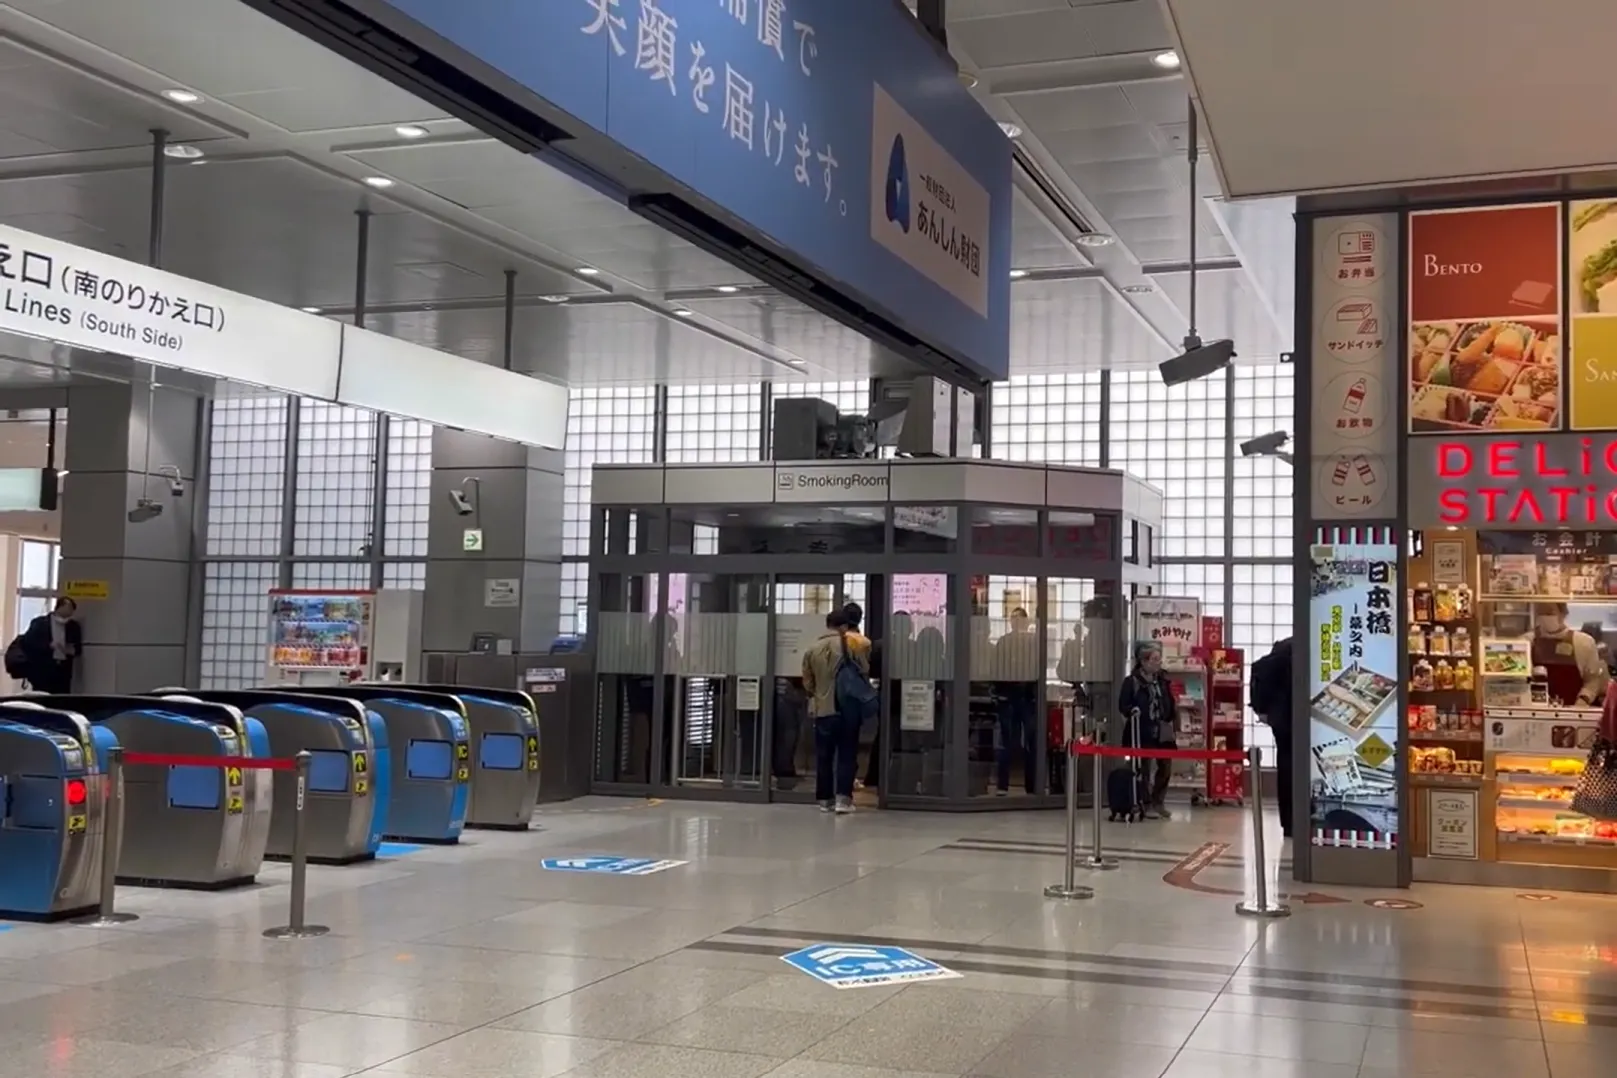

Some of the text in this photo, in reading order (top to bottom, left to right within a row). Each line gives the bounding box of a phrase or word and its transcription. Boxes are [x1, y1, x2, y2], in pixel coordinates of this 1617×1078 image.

[917, 200, 980, 277] あんしん財団
[1337, 267, 1376, 279] お弁当
[4, 288, 183, 351] Lines (South Side)
[1327, 339, 1384, 350] サンドイッチ
[1336, 495, 1372, 505] ビール
[1366, 561, 1391, 635] 日本橋
